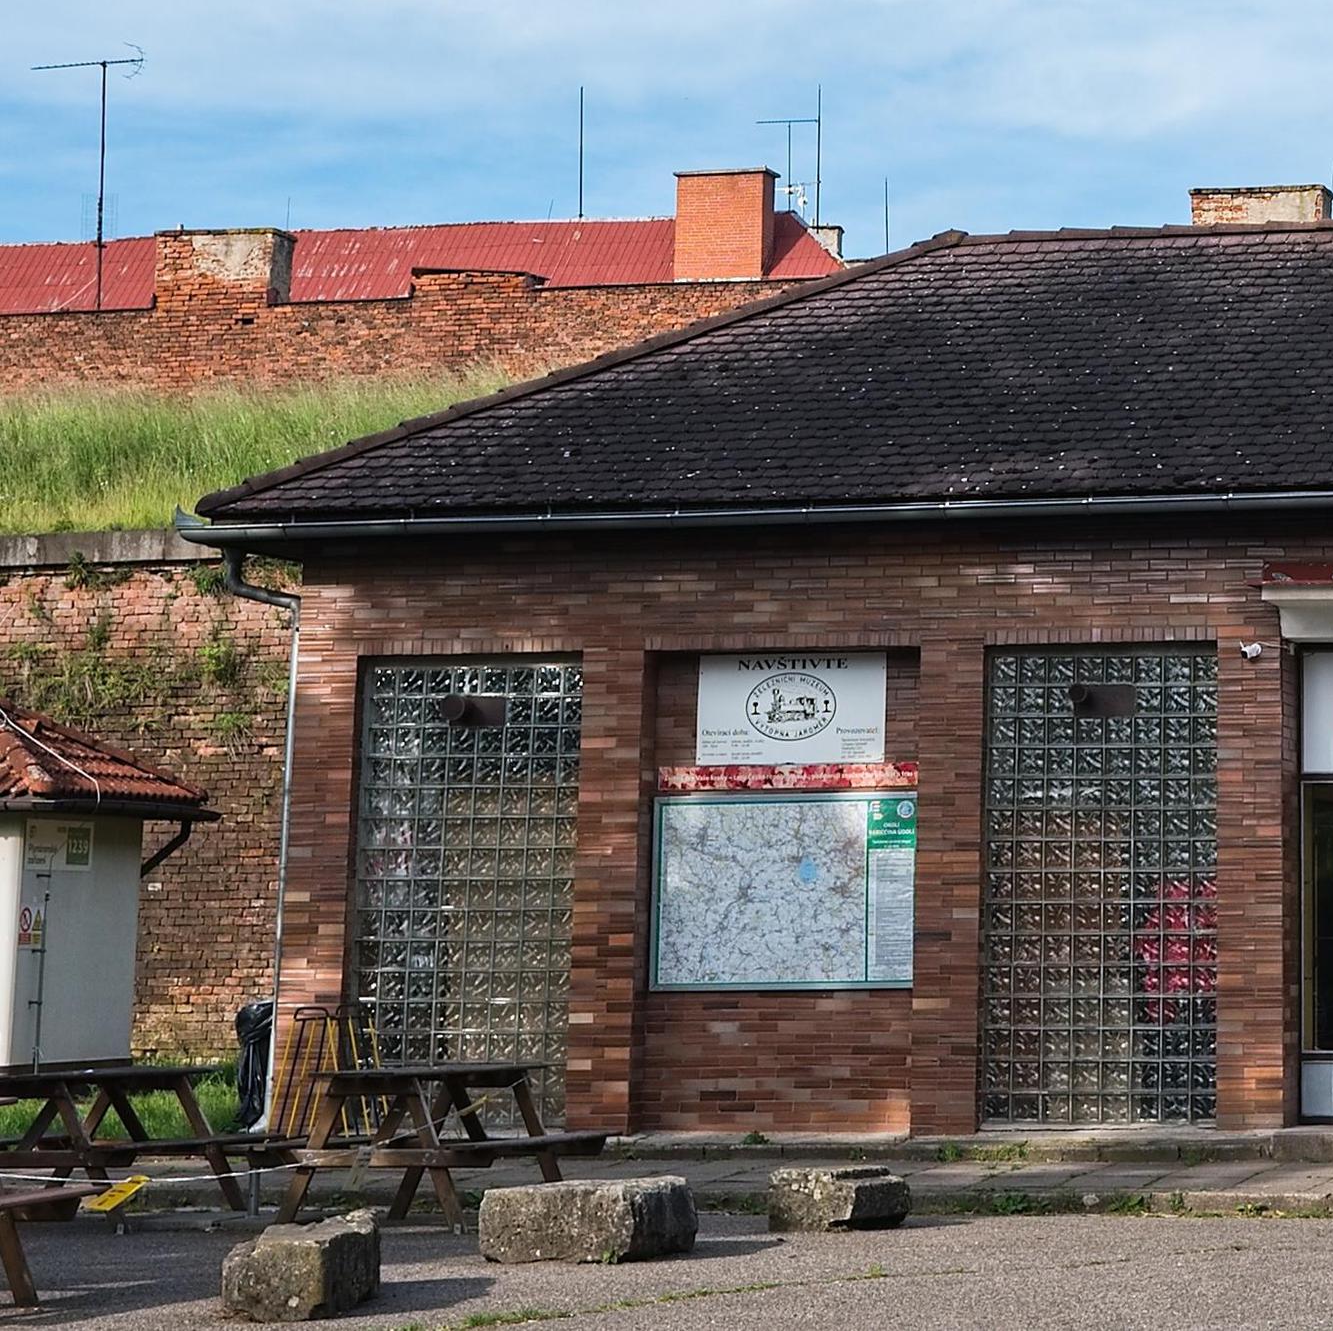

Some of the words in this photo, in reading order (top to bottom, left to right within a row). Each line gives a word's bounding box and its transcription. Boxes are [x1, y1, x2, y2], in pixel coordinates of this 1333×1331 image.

[738, 656, 848, 671] NAVŠTIVTE
[800, 676, 830, 697] MUZEUM
[68, 838, 89, 855] 1239
